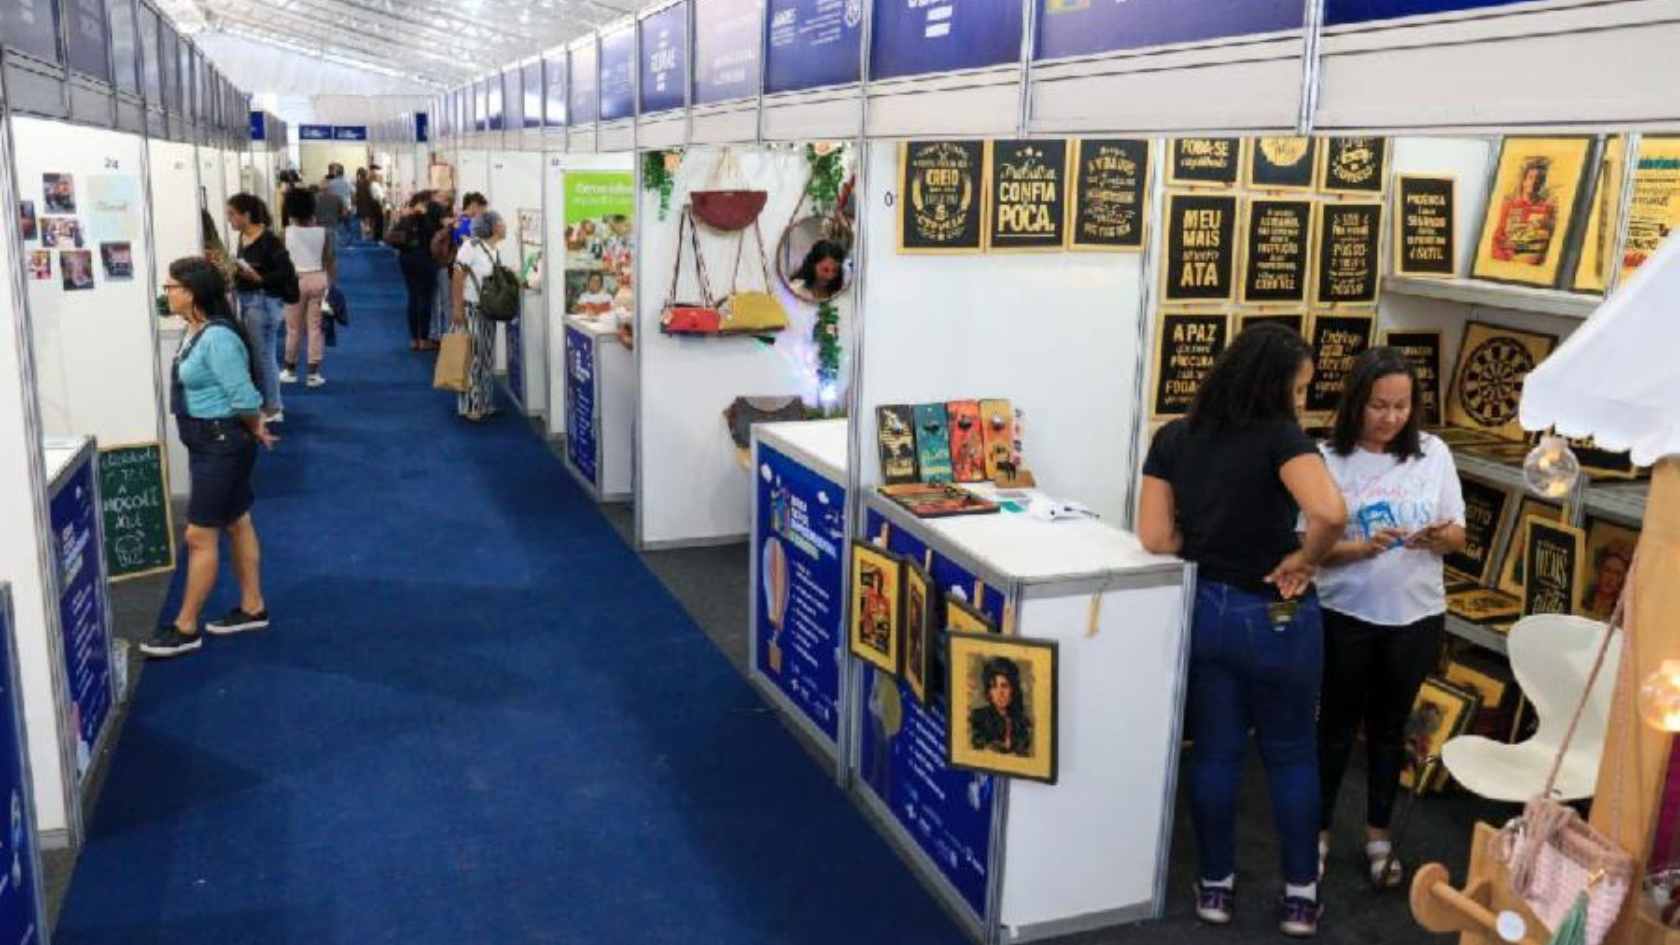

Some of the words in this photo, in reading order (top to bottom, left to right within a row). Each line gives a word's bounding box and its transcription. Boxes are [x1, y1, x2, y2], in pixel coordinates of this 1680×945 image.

[1000, 182, 1056, 202] CONFIA
[1183, 210, 1222, 229] MEU
[1183, 230, 1220, 247] MAIS
[1180, 262, 1219, 287] ATA
[1173, 323, 1184, 342] A
[1186, 323, 1217, 342] PAZ
